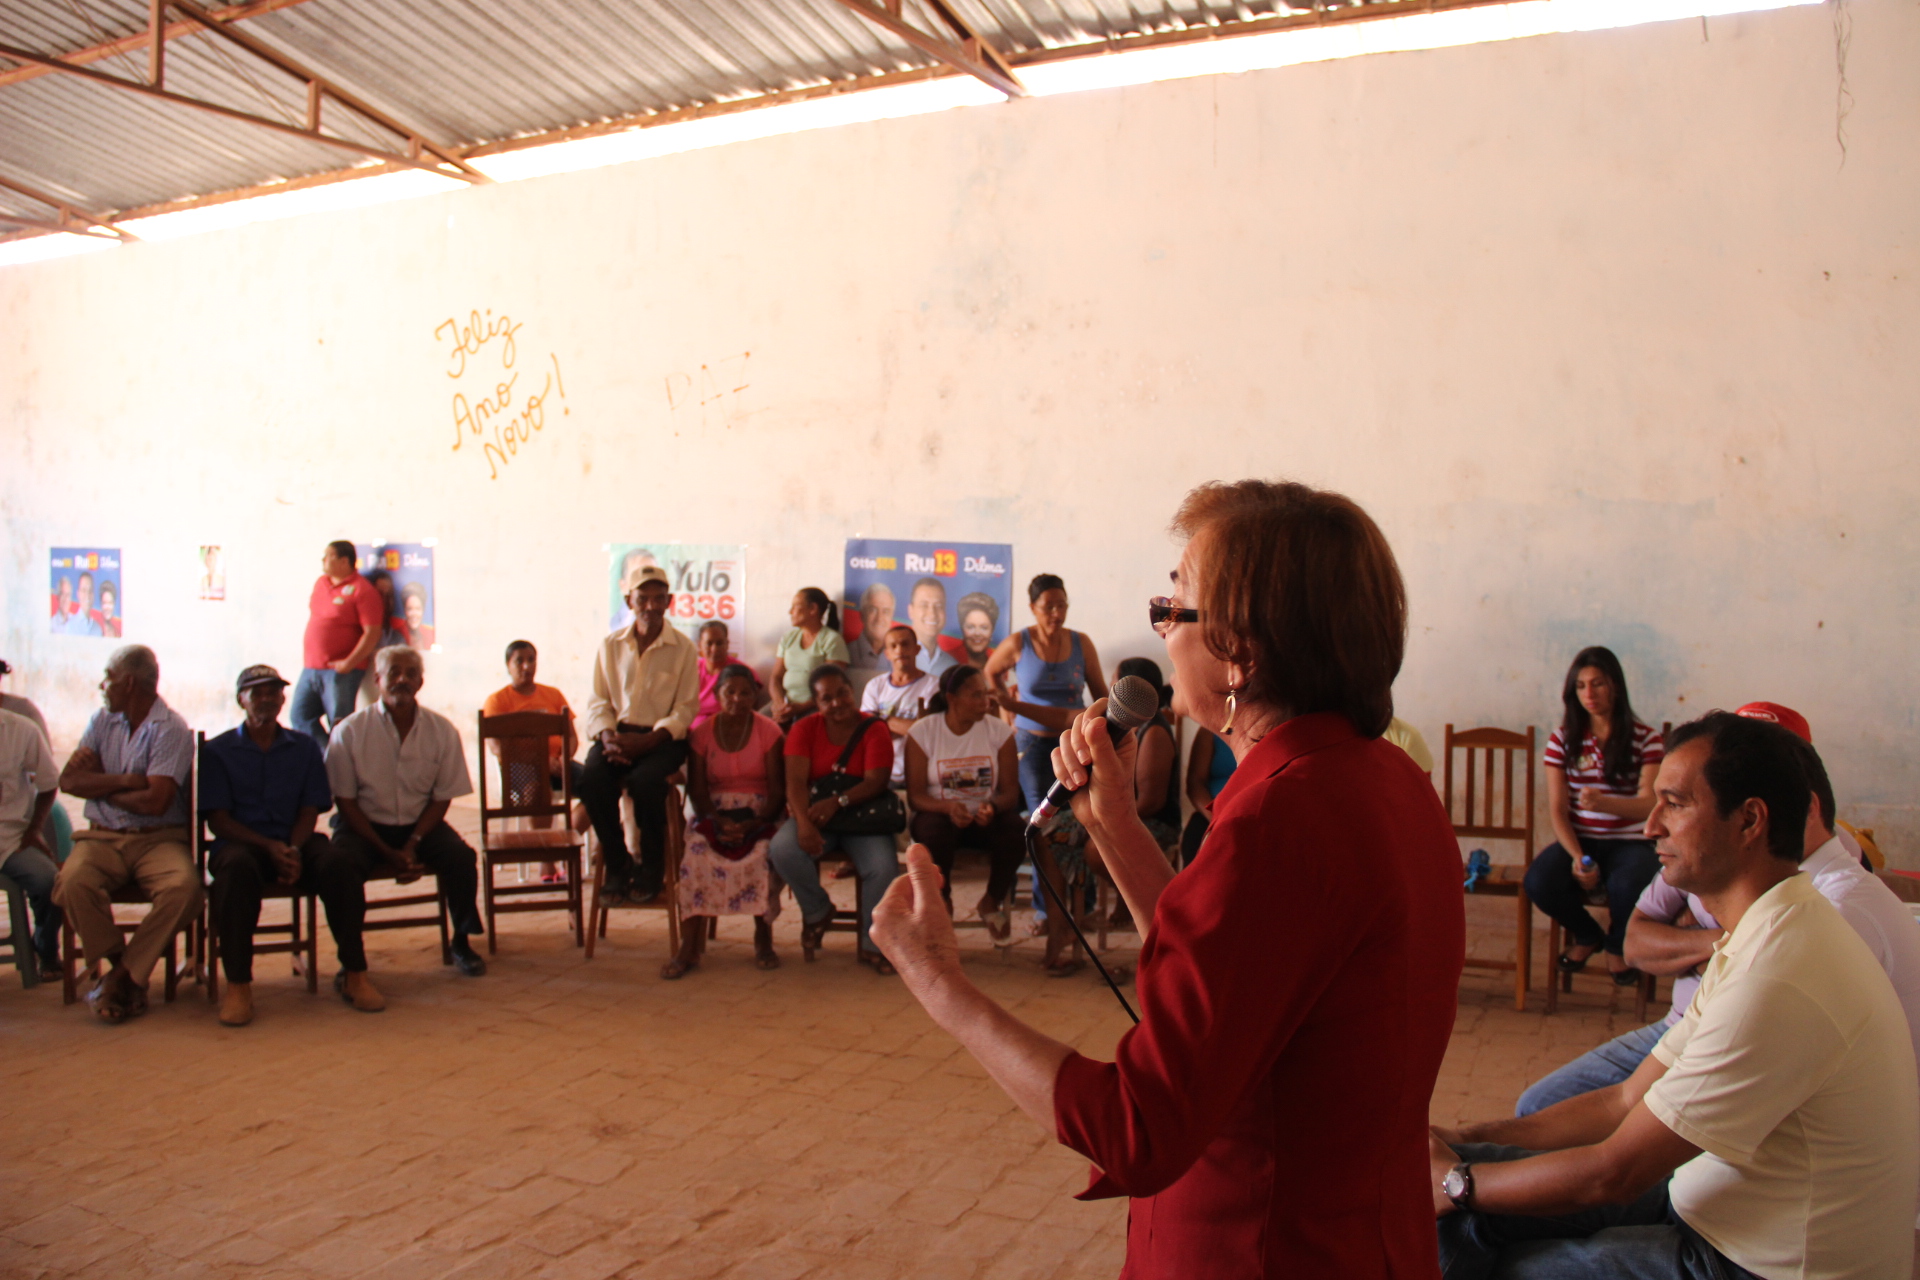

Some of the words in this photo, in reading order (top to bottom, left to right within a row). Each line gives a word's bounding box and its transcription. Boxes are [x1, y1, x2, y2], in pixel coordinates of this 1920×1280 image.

[434, 308, 523, 379] Feliz
[452, 371, 519, 452] Ano
[670, 560, 731, 593] Yulo
[963, 556, 1006, 574] Dilma
[668, 593, 736, 620] 1336
